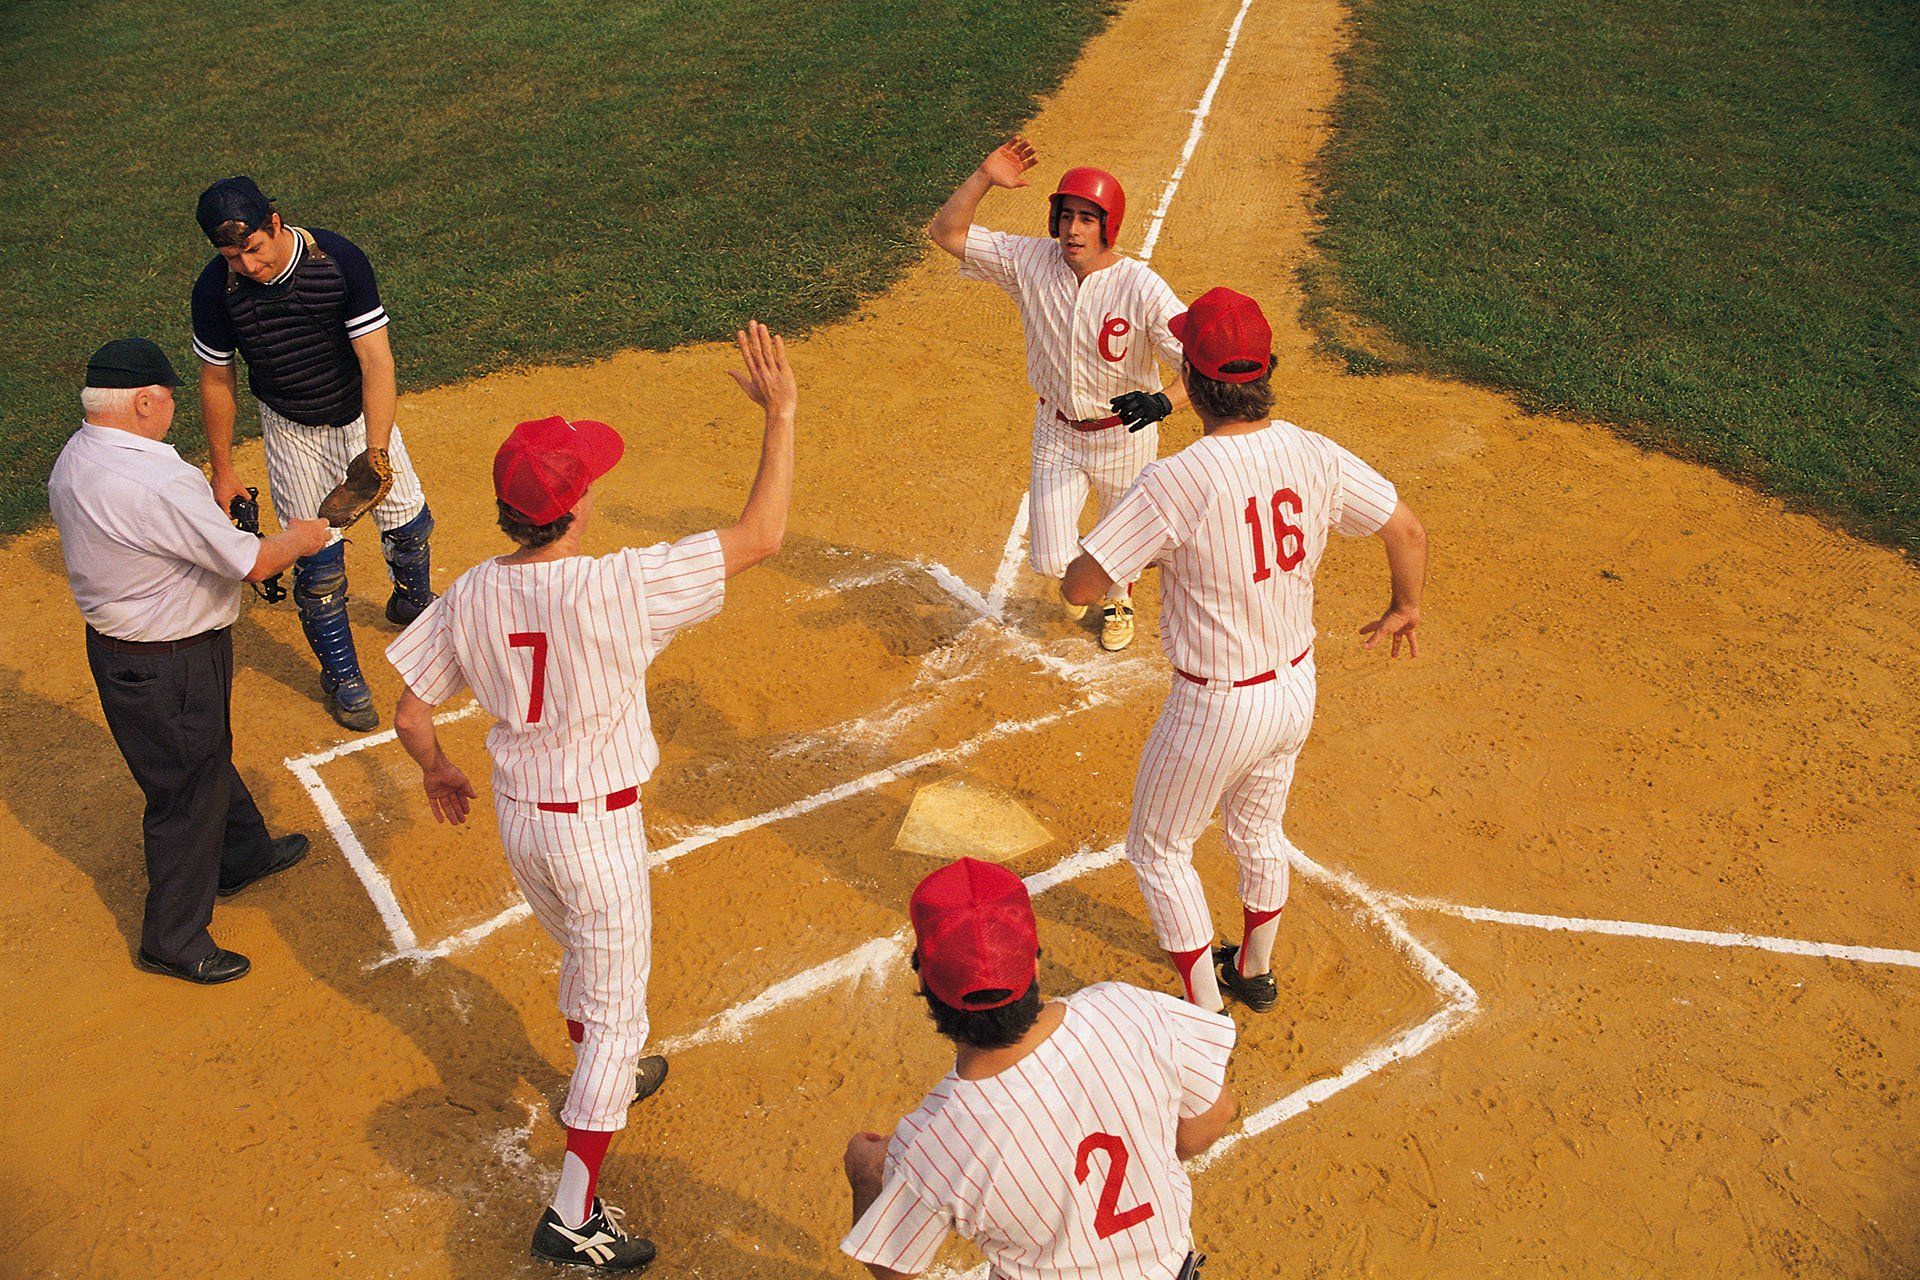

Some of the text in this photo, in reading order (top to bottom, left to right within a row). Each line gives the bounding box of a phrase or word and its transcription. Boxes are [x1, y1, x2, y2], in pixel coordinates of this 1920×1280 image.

[1244, 487, 1307, 584] 16
[509, 632, 548, 724] 7
[1074, 1131, 1155, 1240] 2
